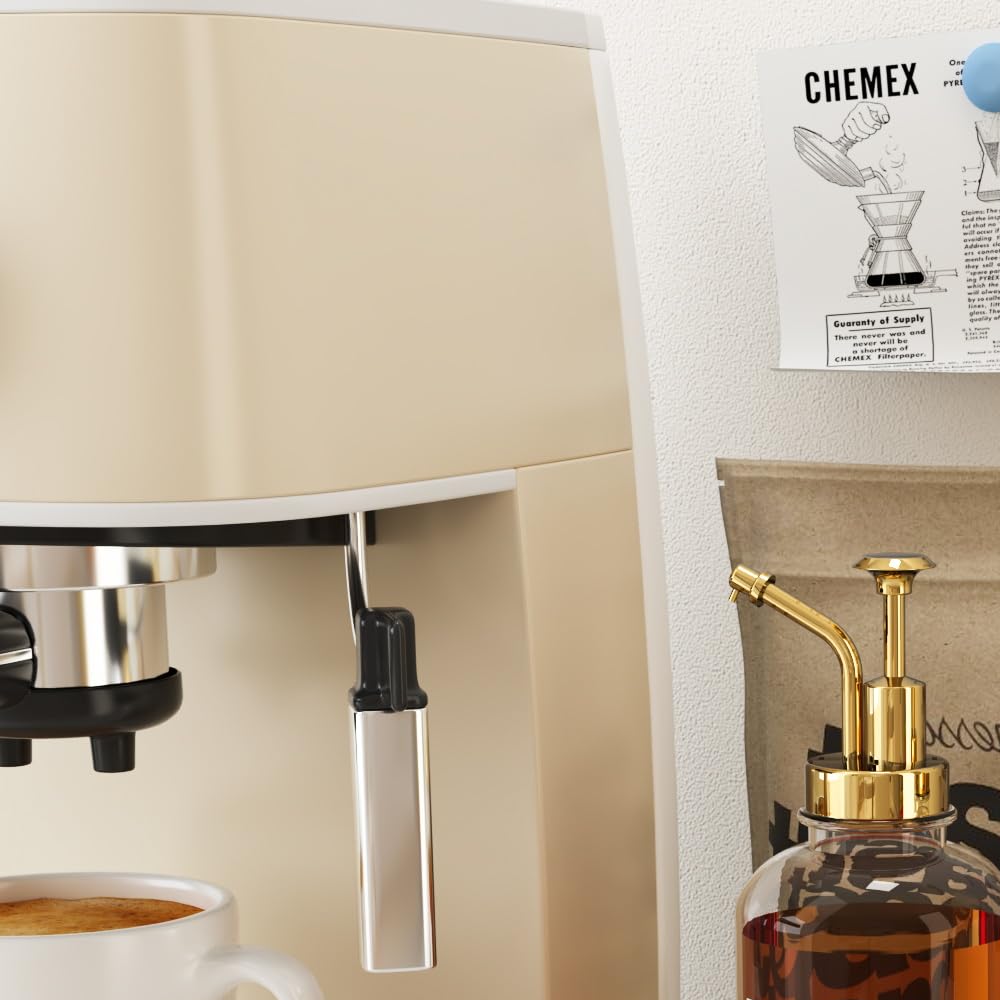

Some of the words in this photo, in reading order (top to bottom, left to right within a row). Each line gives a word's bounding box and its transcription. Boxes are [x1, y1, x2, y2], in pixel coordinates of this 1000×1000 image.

[804, 62, 920, 105] CHEMEX
[833, 319, 876, 329] Guaranty
[879, 316, 890, 325] of
[893, 314, 925, 325] Supply
[909, 328, 926, 336] and
[834, 355, 872, 363] CHEMEX
